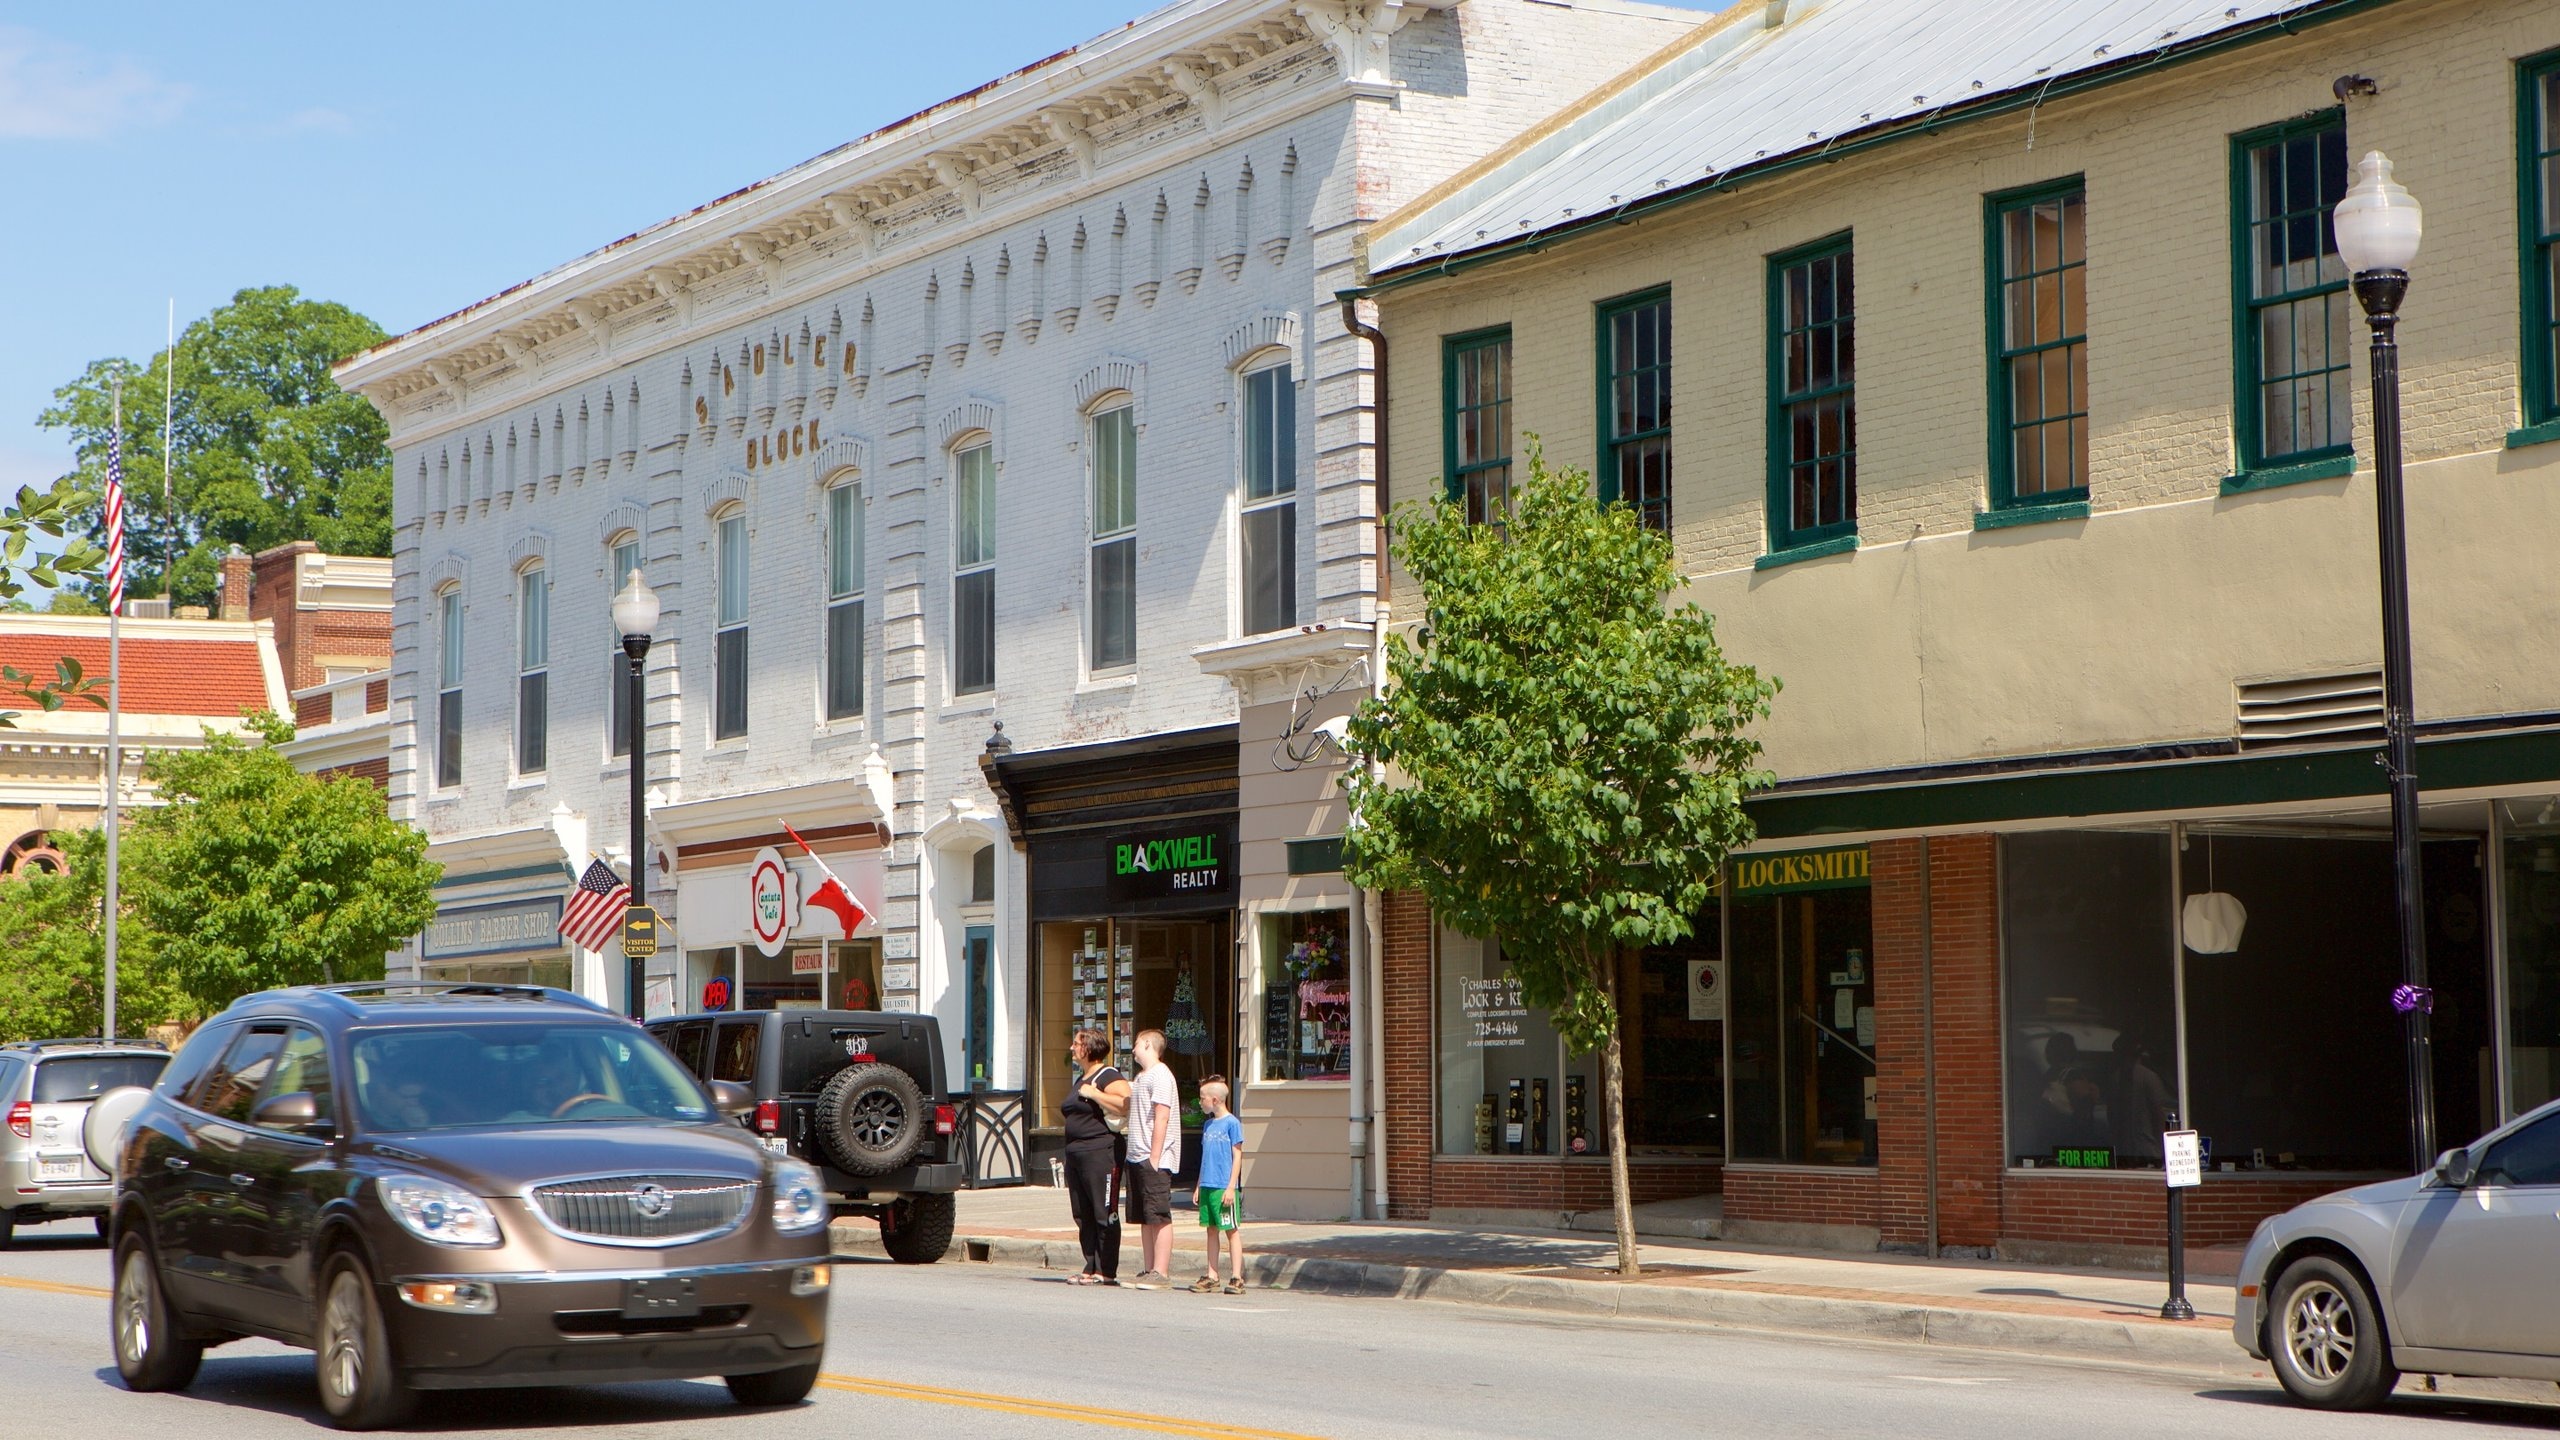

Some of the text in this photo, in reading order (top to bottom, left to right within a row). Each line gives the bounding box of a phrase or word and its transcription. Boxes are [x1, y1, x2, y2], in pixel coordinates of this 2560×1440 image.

[695, 333, 858, 426] SADLER
[1116, 835, 1218, 875] BLACKWELL
[1173, 869, 1218, 889] REALTY
[480, 913, 520, 944] BARBER
[524, 911, 549, 939] SHOP
[1468, 979, 1502, 990] CHARLES
[703, 981, 729, 1007] OPEN
[1495, 993, 1504, 1007] &
[1509, 991, 1522, 1006] KE
[1467, 1010, 1487, 1018] COMPLETE
[1475, 1021, 1518, 1036] 728-4346
[2058, 1150, 2110, 1167] FOR RENT
[2169, 1158, 2196, 1167] WEDNESDAY
